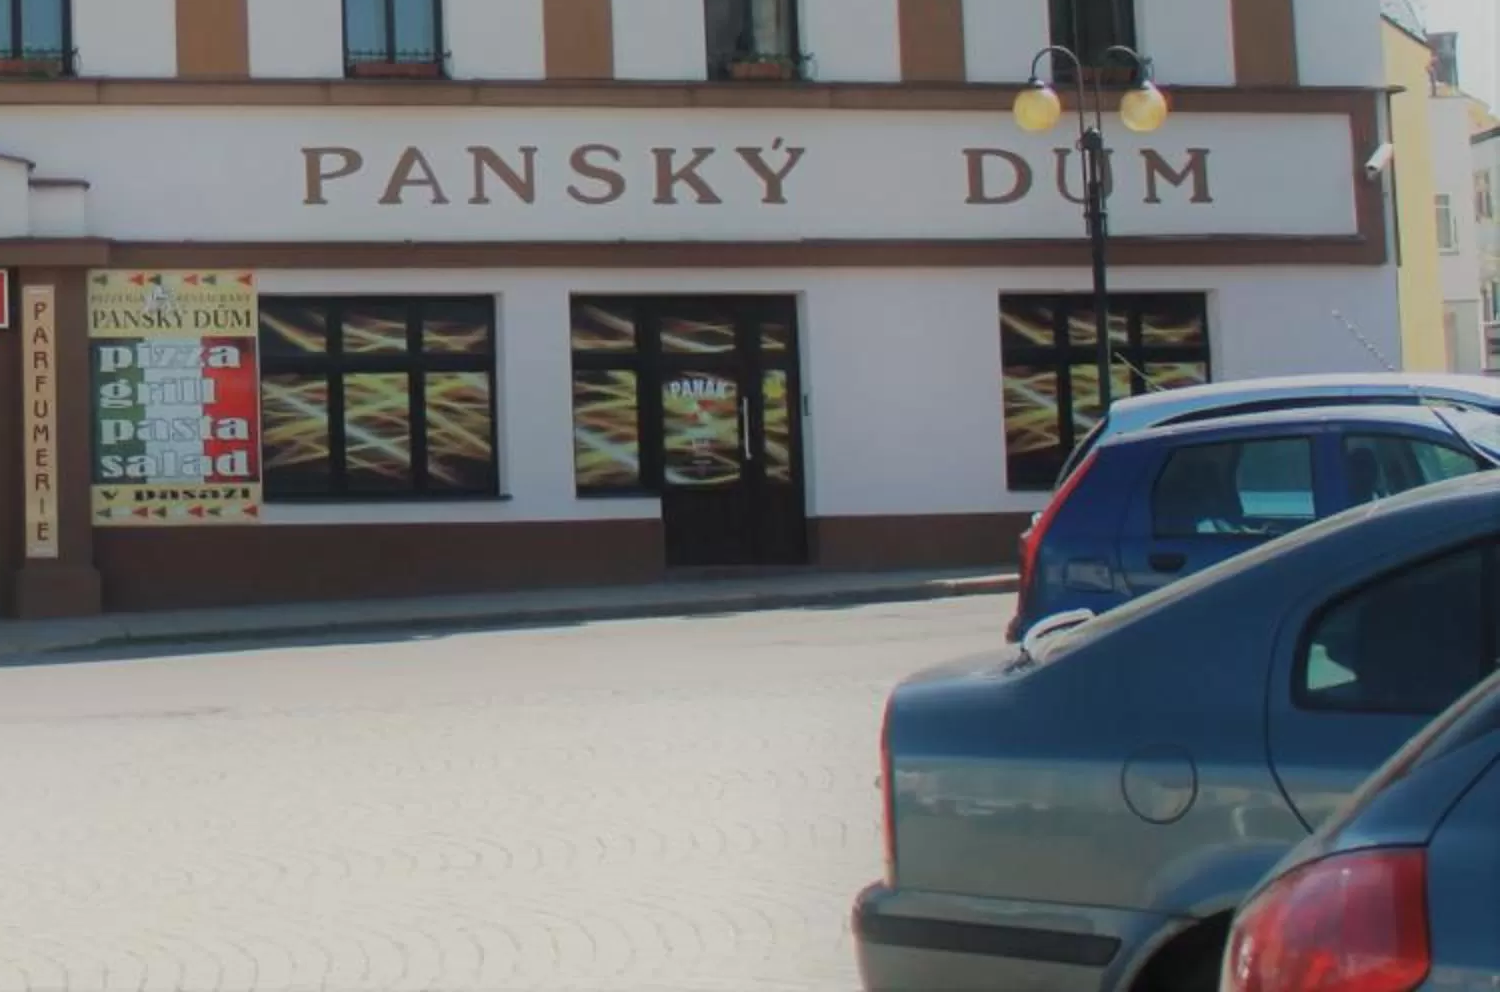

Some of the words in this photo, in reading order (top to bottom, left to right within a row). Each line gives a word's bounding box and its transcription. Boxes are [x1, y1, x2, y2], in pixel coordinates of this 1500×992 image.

[300, 137, 806, 207] PANSKÝ
[100, 341, 241, 373] pizza
[100, 377, 217, 408] grill
[33, 301, 50, 542] PARFUMERIE
[100, 414, 250, 445] pasta
[100, 449, 250, 479] salad
